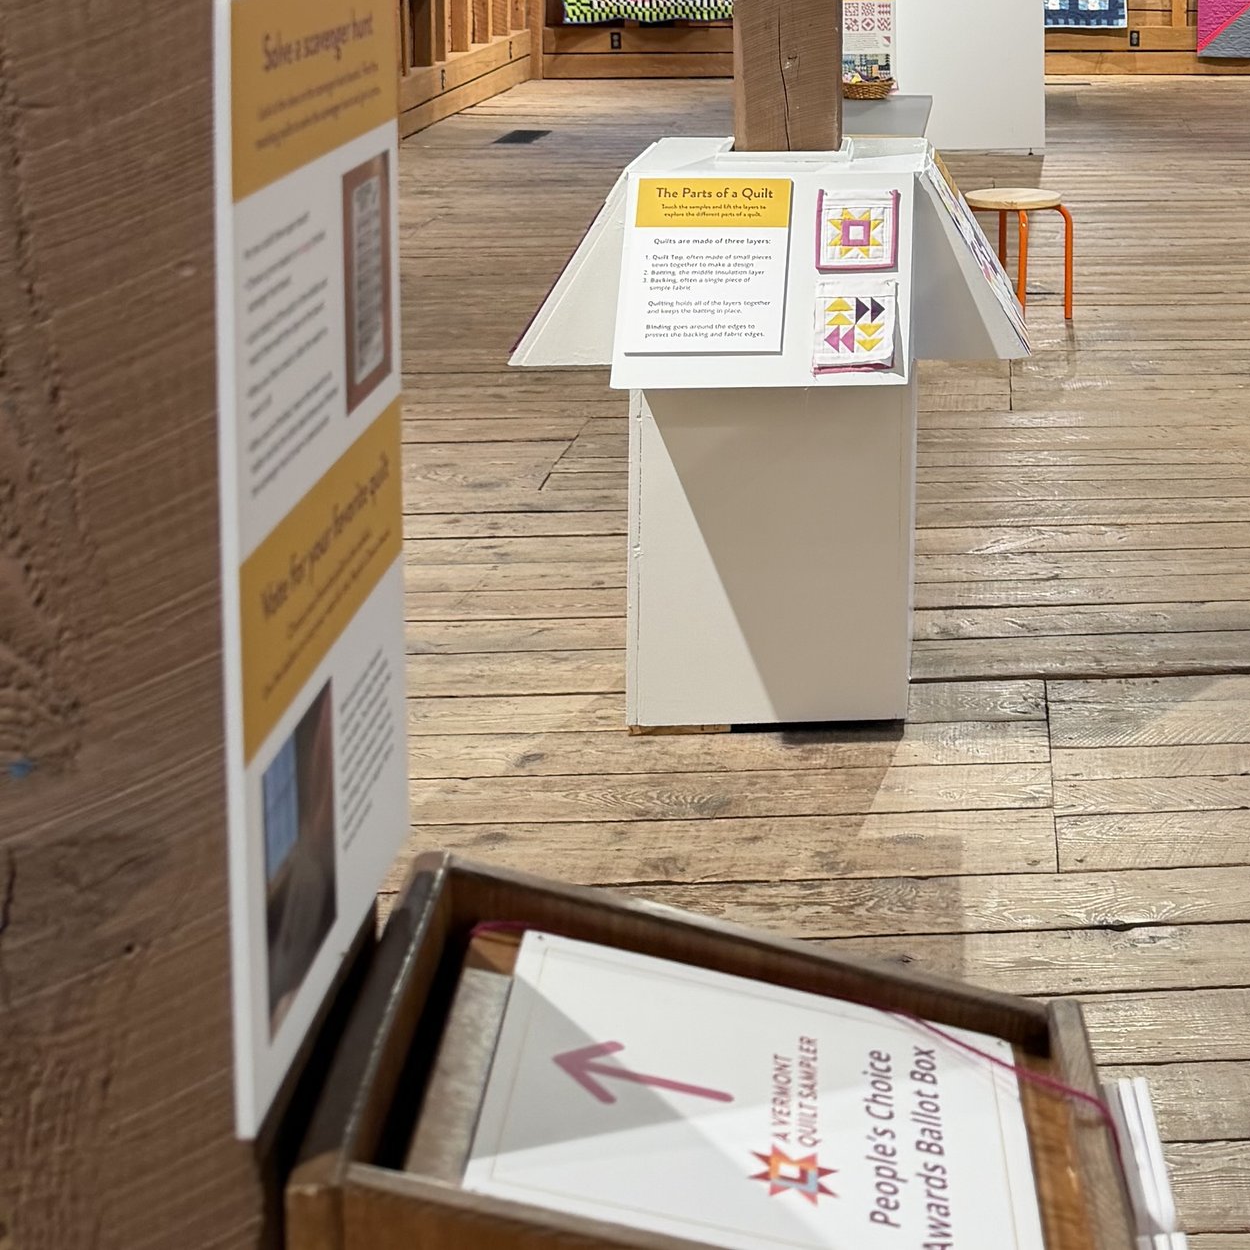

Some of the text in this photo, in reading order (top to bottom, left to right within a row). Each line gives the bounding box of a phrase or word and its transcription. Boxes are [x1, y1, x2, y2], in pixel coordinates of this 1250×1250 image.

[351, 8, 374, 41] hunt
[656, 187, 774, 201] The Parts of a Quilt
[746, 238, 772, 246] layers:
[797, 1035, 822, 1148] QUILT SAMPLER
[909, 1045, 938, 1086] Box
[771, 1053, 793, 1144] A VERMONT
[910, 1089, 946, 1156] Ballot
[861, 1049, 909, 1229] People's Choice
